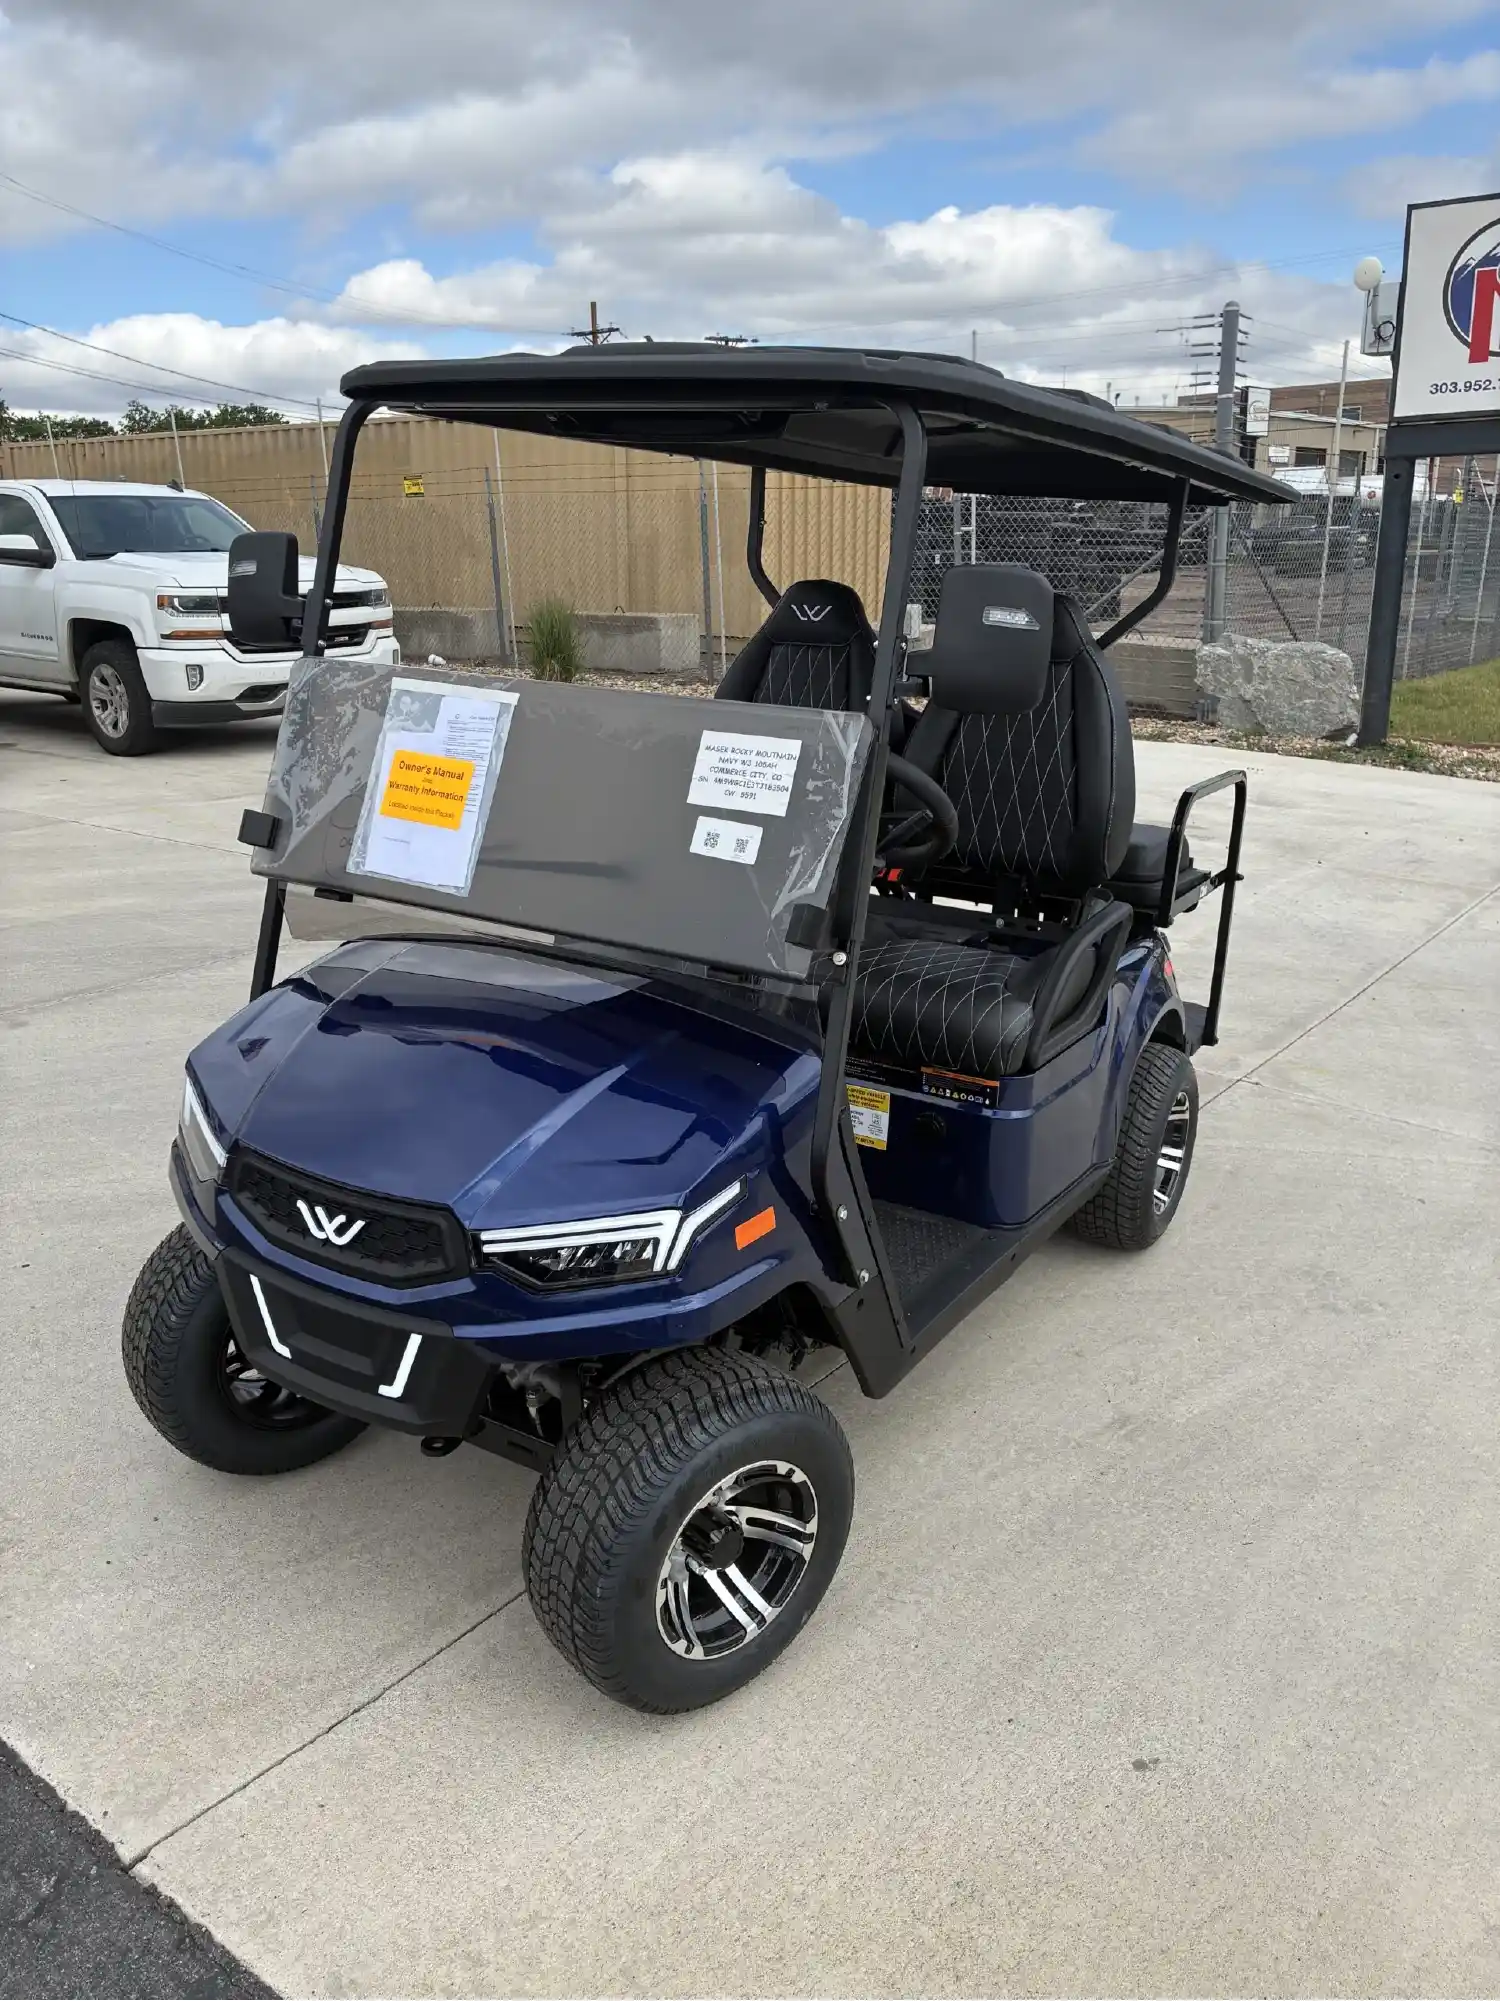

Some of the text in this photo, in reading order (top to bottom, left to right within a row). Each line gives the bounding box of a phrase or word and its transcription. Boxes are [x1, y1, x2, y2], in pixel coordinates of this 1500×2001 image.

[1429, 378, 1500, 395] 303.952.
[705, 745, 729, 753] MASEK
[731, 747, 754, 756] ROCKY
[718, 756, 738, 764] NAVY
[399, 760, 465, 780] Owner's Manual
[709, 766, 747, 778] COMMERCE
[771, 773, 783, 781] CO
[389, 780, 464, 802] Warranty Information
